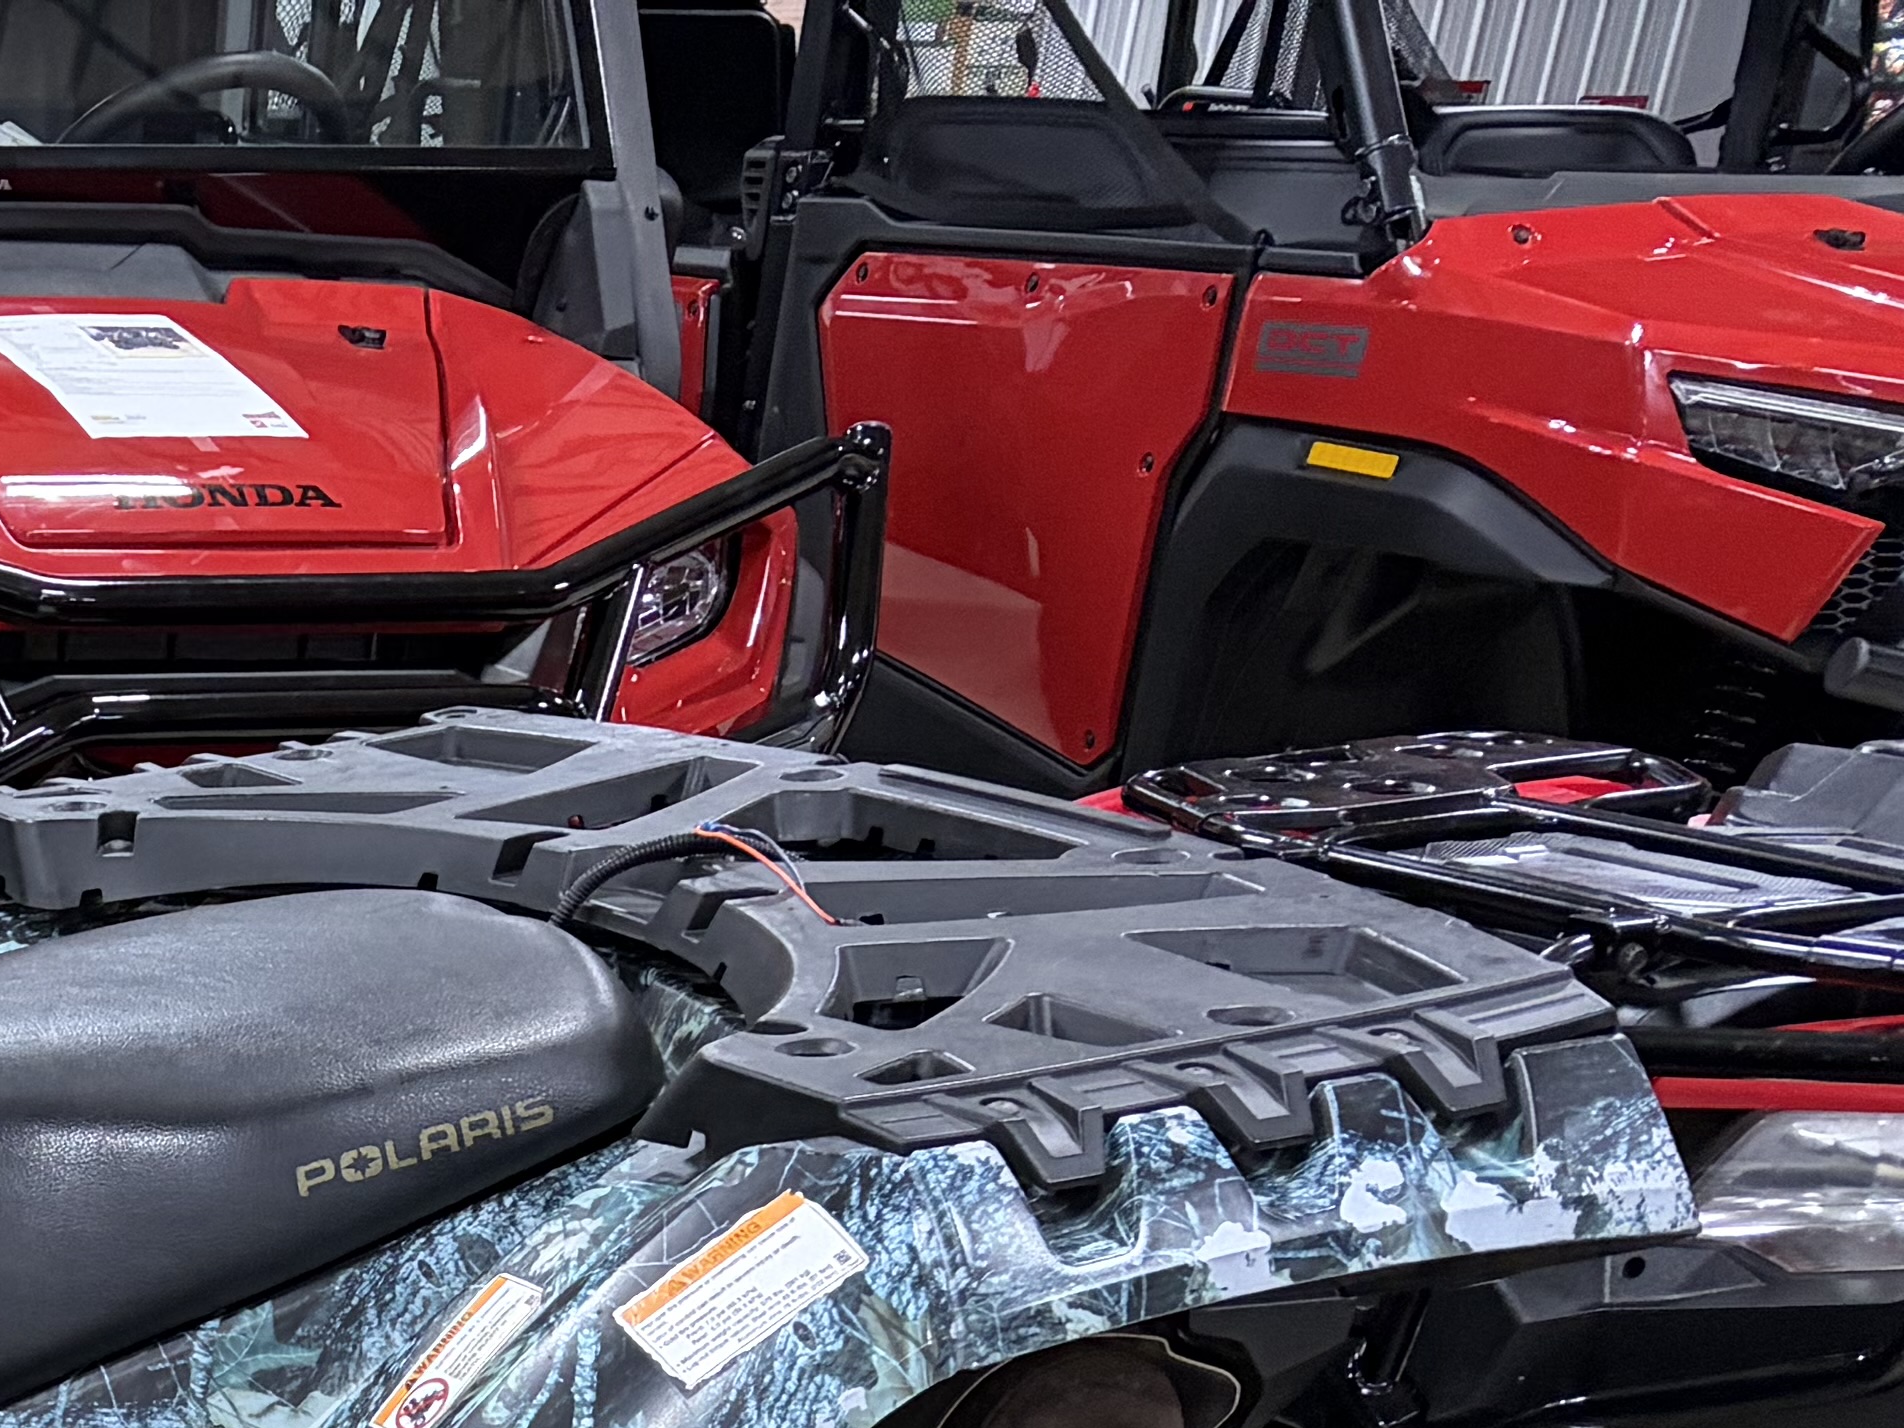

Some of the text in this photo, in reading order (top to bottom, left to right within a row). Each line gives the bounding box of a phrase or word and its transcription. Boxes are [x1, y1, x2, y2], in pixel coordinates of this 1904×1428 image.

[1268, 329, 1360, 357] DCT
[113, 484, 342, 510] HONDA
[295, 1096, 555, 1197] POLARIS
[681, 1221, 762, 1281] WARNING
[413, 1311, 473, 1377] WARNING
